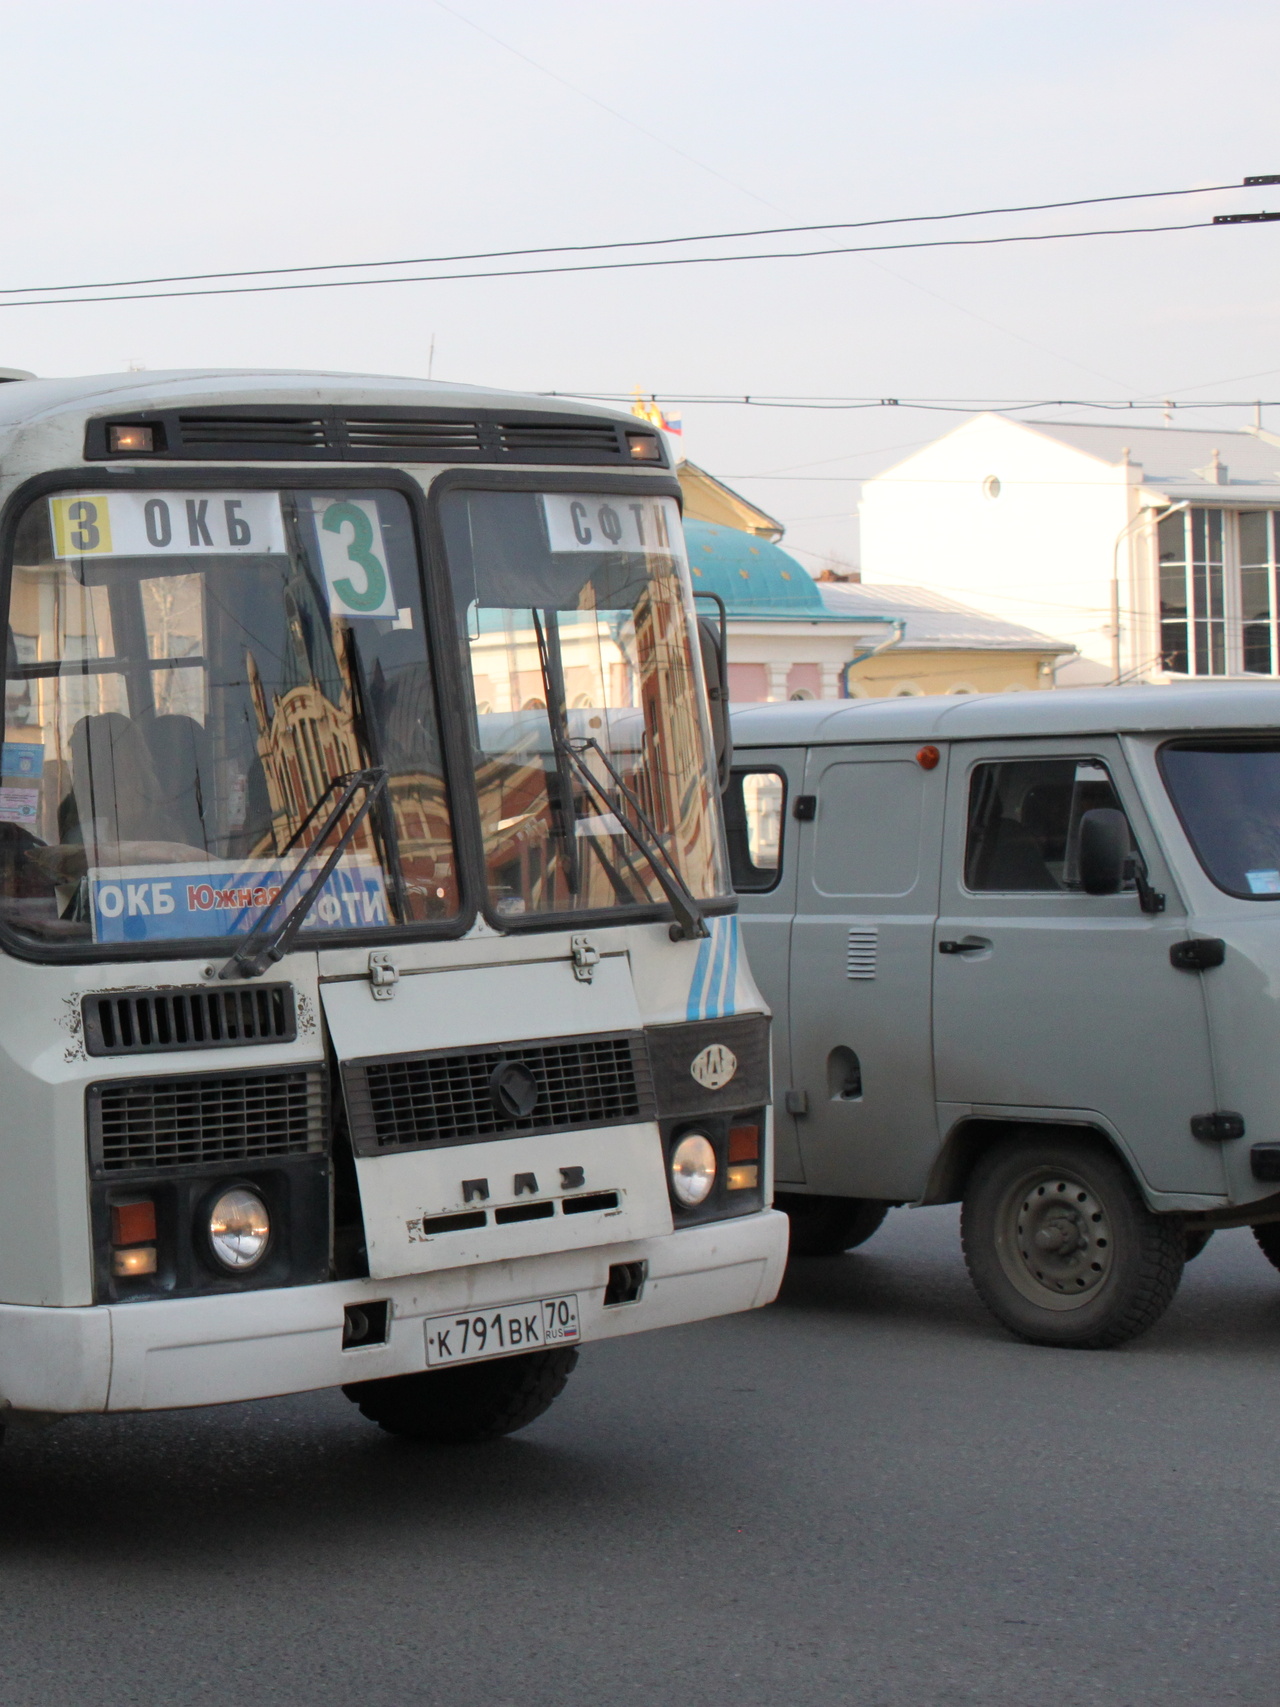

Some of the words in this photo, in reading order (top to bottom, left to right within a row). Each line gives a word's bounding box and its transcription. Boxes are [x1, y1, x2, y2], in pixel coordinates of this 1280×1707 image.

[67, 500, 101, 551] 3
[143, 498, 252, 548] ОКБ
[570, 500, 671, 548] СФТИ
[321, 502, 388, 613] 3
[98, 882, 176, 919] ОКБ
[186, 883, 282, 912] Южная
[428, 1313, 540, 1357] К791ВК
[544, 1300, 570, 1328] 70
[545, 1329, 564, 1339] RUS
